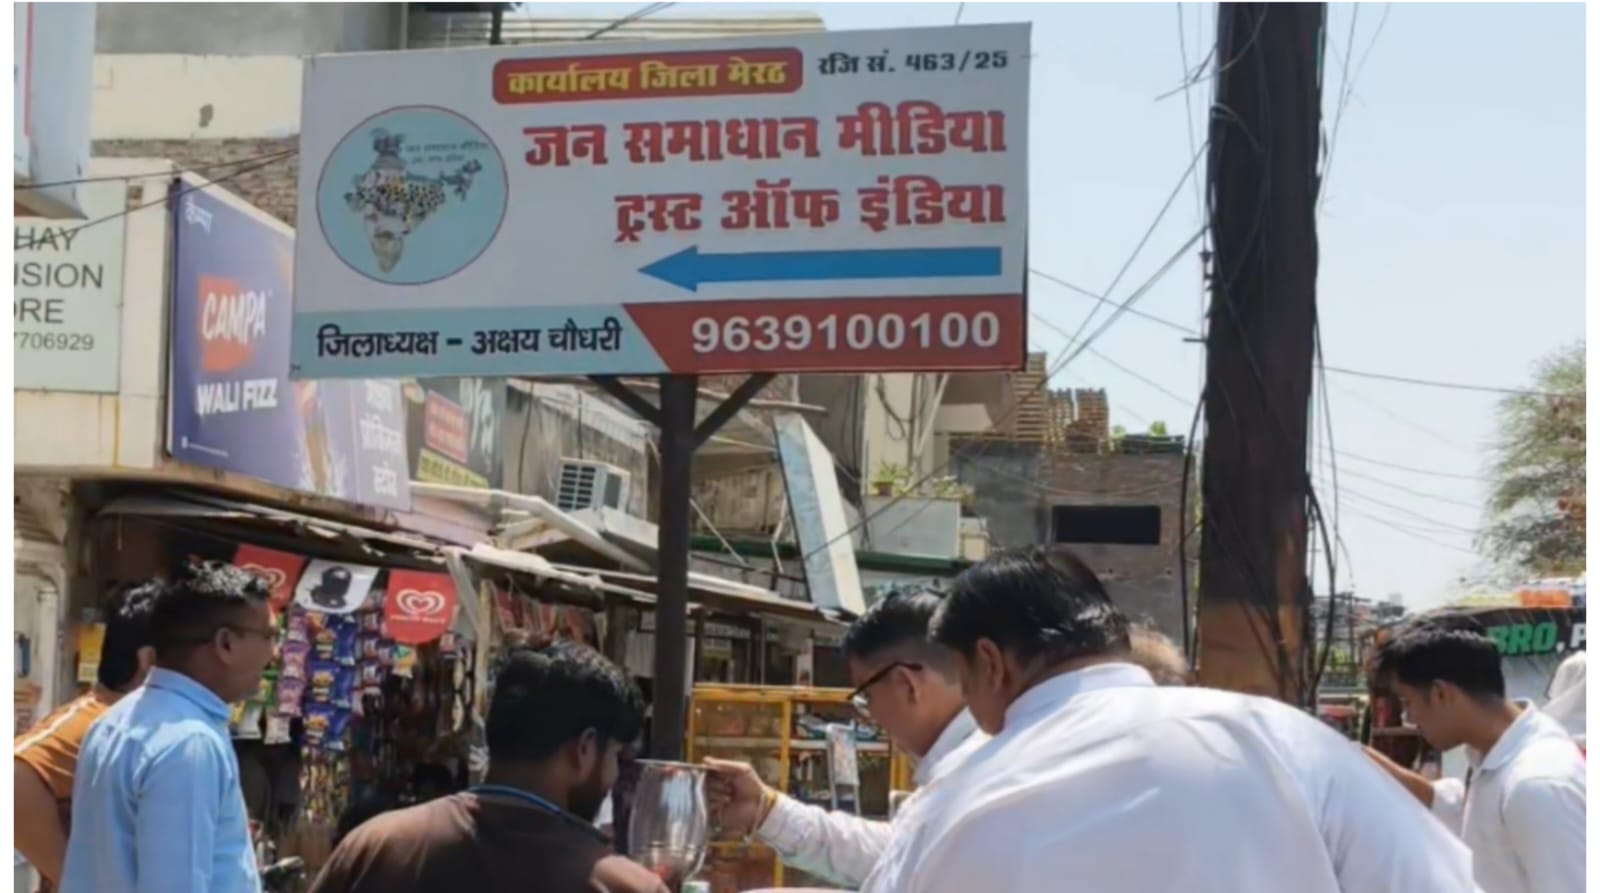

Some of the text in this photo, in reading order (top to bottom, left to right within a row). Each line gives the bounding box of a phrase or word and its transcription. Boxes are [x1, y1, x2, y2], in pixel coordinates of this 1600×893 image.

[508, 57, 788, 94] कार्यालय जिला मेरठ
[818, 52, 860, 75] रजि
[905, 49, 1008, 72] 463/25
[523, 101, 1007, 167] जन समाधान मीडिया
[614, 176, 1007, 242] ट्रस्ट ऑफ इंडिया
[14, 297, 65, 324] RE
[202, 291, 266, 345] CAMPA
[317, 323, 439, 358] जिलाध्यक्ष
[471, 328, 541, 354] अक्षय
[548, 317, 623, 352] चौधरी
[691, 311, 1000, 353] 9639100100
[197, 378, 278, 416] WALI FIZZ
